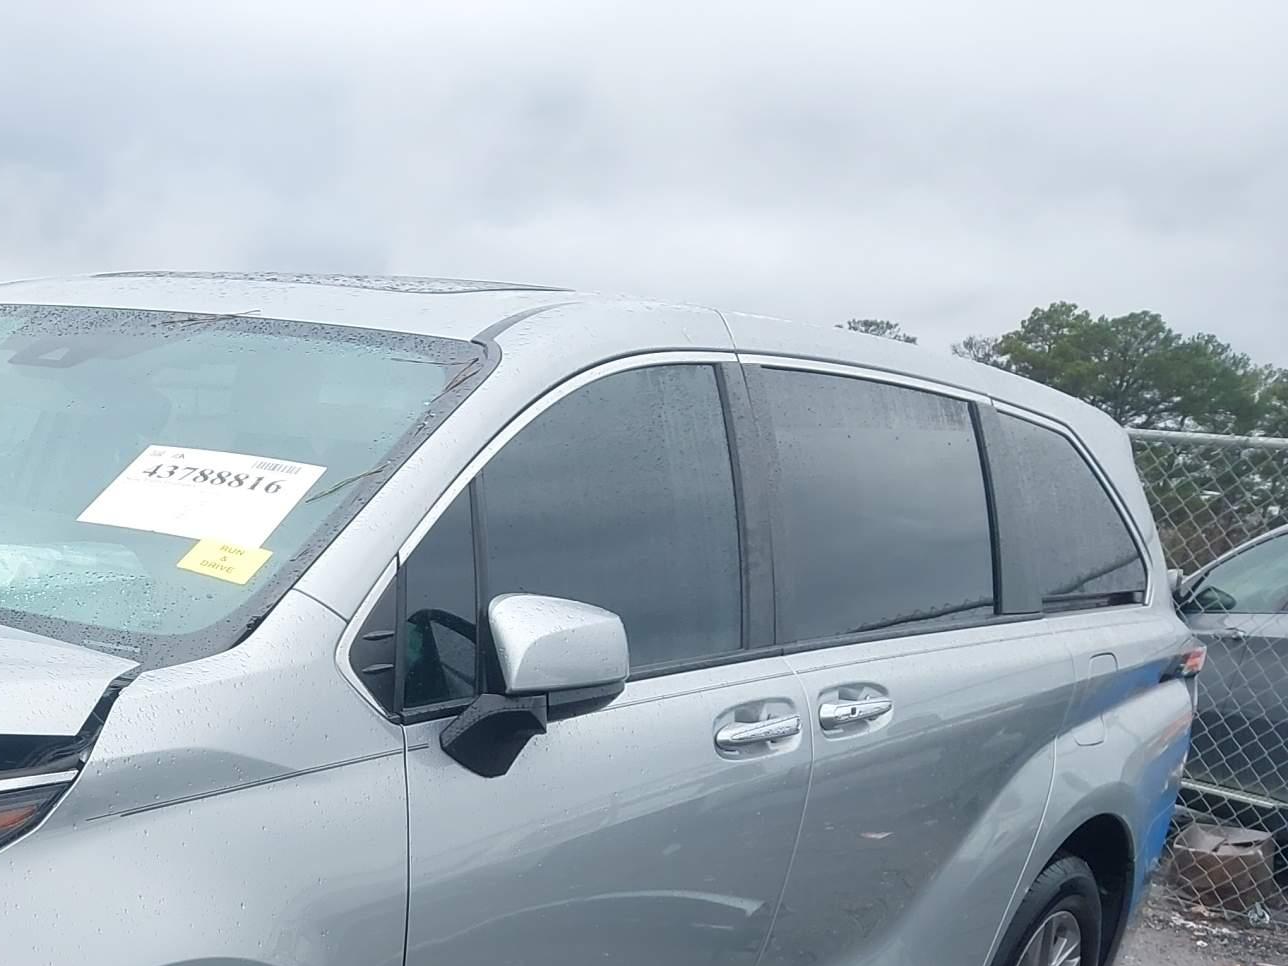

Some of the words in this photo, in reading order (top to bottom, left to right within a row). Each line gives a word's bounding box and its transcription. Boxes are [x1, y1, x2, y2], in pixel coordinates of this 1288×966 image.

[142, 463, 285, 494] 43788816
[219, 544, 246, 556] RUN
[200, 559, 235, 574] DRIVE
